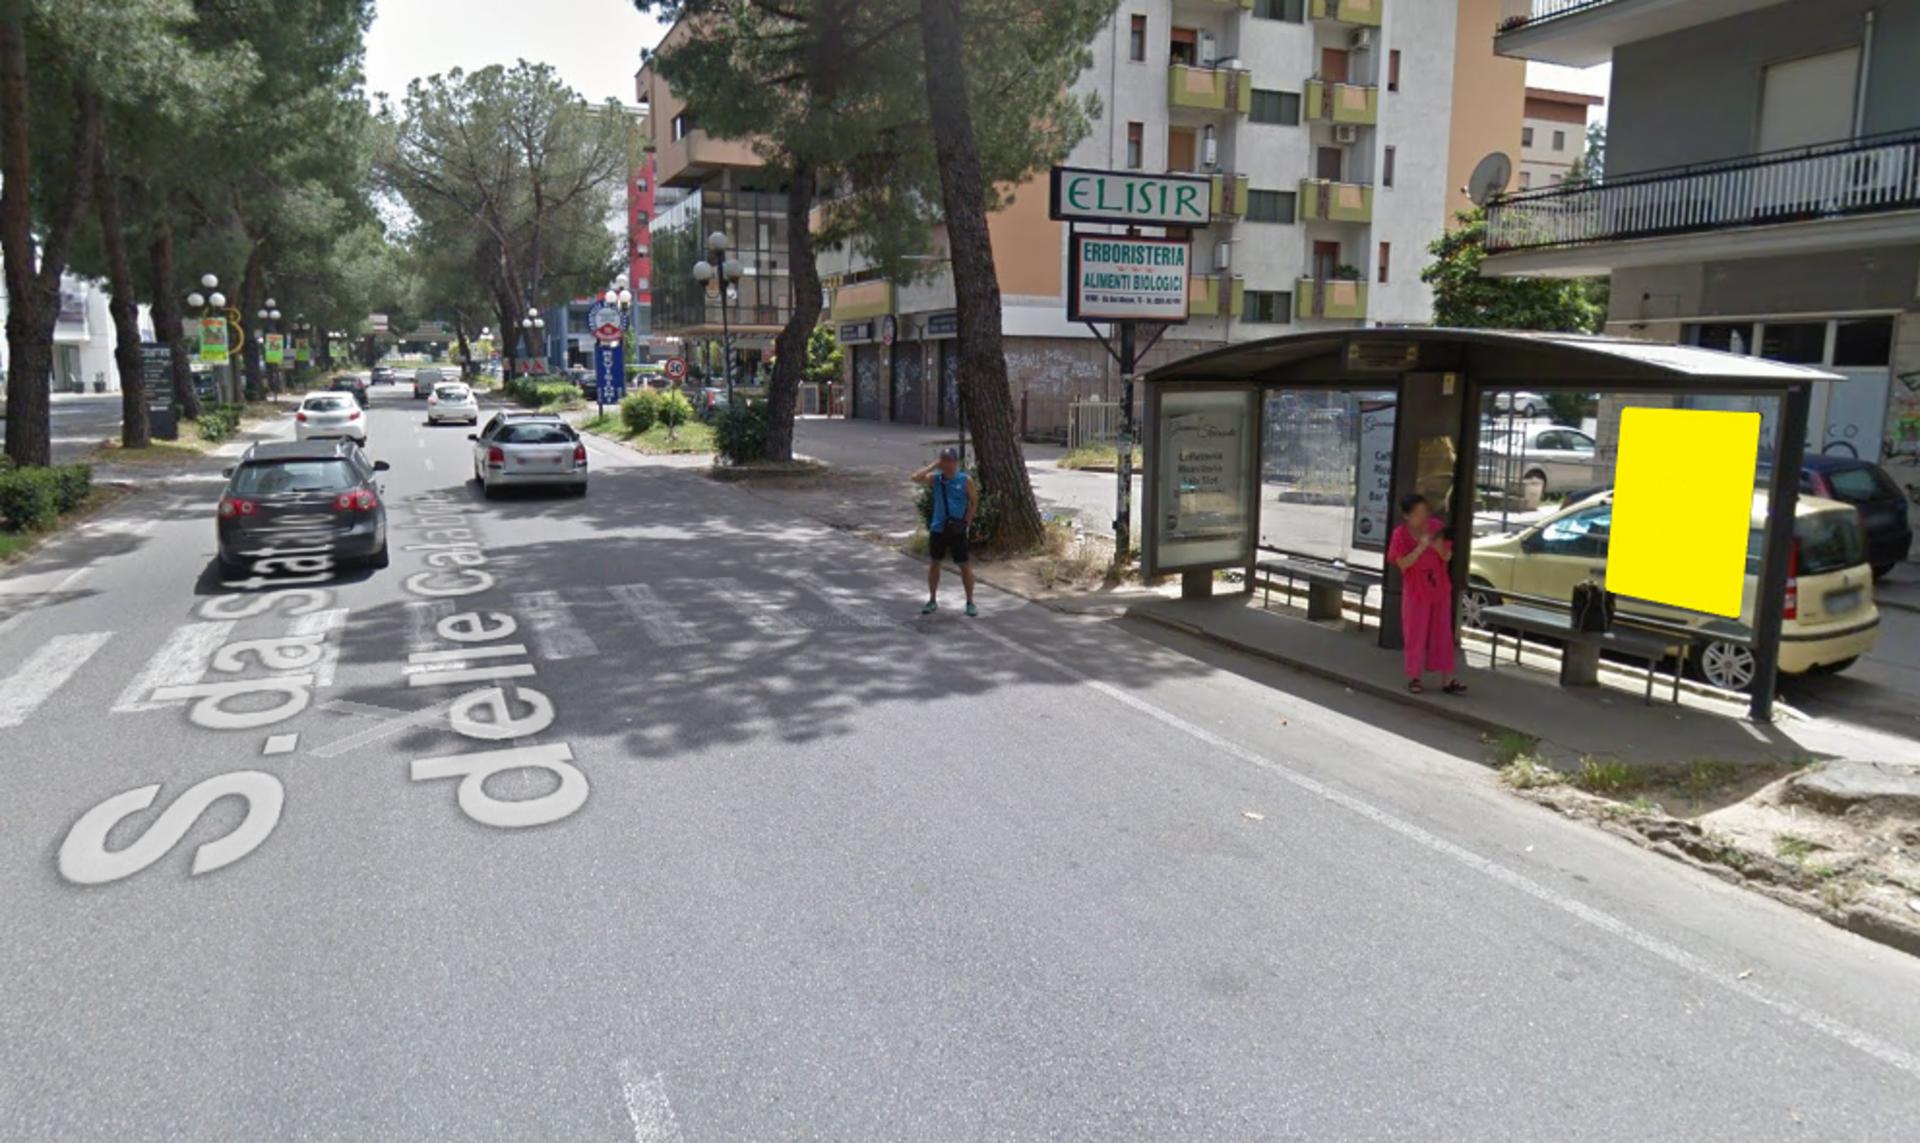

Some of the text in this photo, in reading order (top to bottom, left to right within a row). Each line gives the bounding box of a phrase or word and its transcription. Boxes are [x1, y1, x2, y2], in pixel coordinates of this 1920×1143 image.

[1067, 177, 1202, 217] ELISIR
[1084, 242, 1185, 266] ERBORISTERIA
[1084, 273, 1183, 292] ALIMENTI BIOLOGICI
